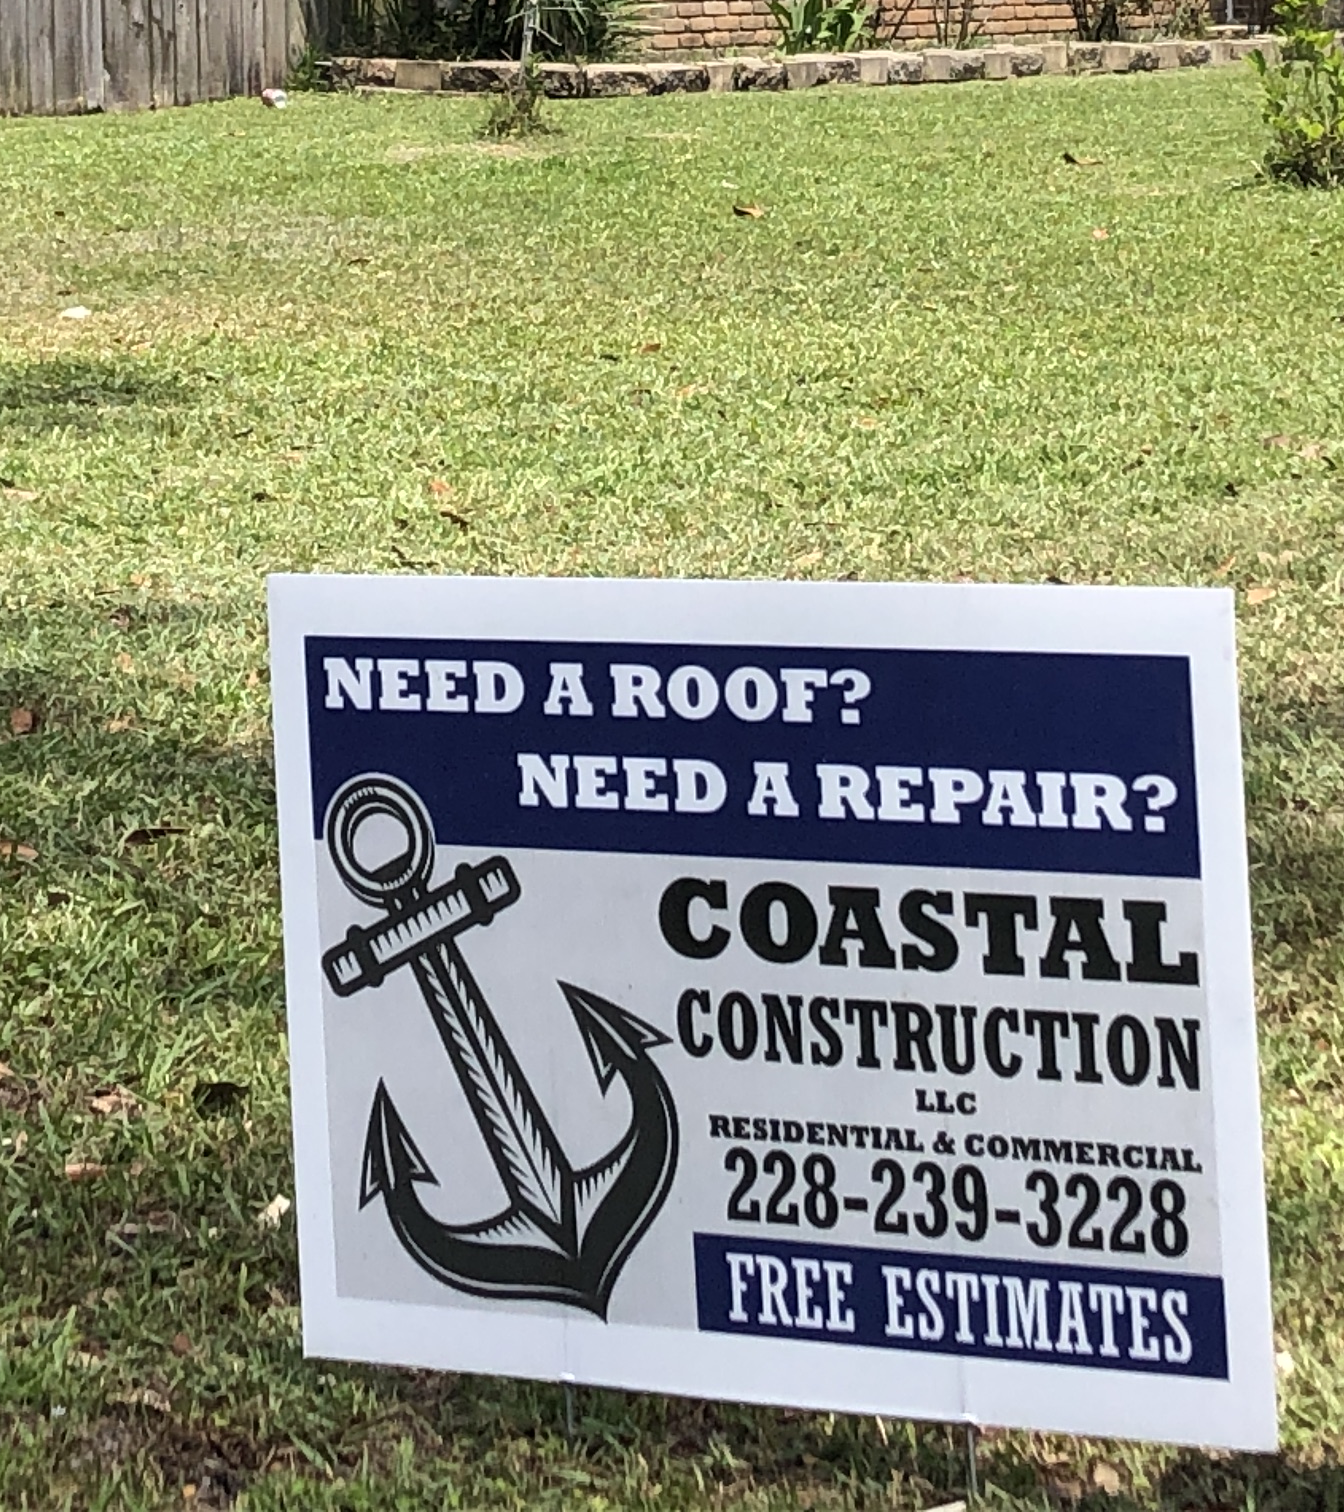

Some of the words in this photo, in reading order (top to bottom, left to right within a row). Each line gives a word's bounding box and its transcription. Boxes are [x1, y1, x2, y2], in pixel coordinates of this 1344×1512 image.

[323, 657, 524, 713] NEED
[544, 662, 593, 716] A
[610, 664, 871, 724] ROOF?
[517, 753, 727, 813] NEED
[747, 761, 799, 817] A
[816, 763, 1178, 832] REPAIR?
[658, 877, 1200, 986] COASTAL
[676, 988, 1200, 1091] CONSTRUCTION
[708, 1114, 924, 1153] RESIDENTIAL
[932, 1131, 956, 1155] &
[964, 1133, 1202, 1174] COMMERCIAL
[915, 1089, 977, 1114] LLC
[723, 1147, 1190, 1258] 228-239-3228
[725, 1251, 855, 1333] FREE
[881, 1265, 1193, 1365] ESTIMATES
